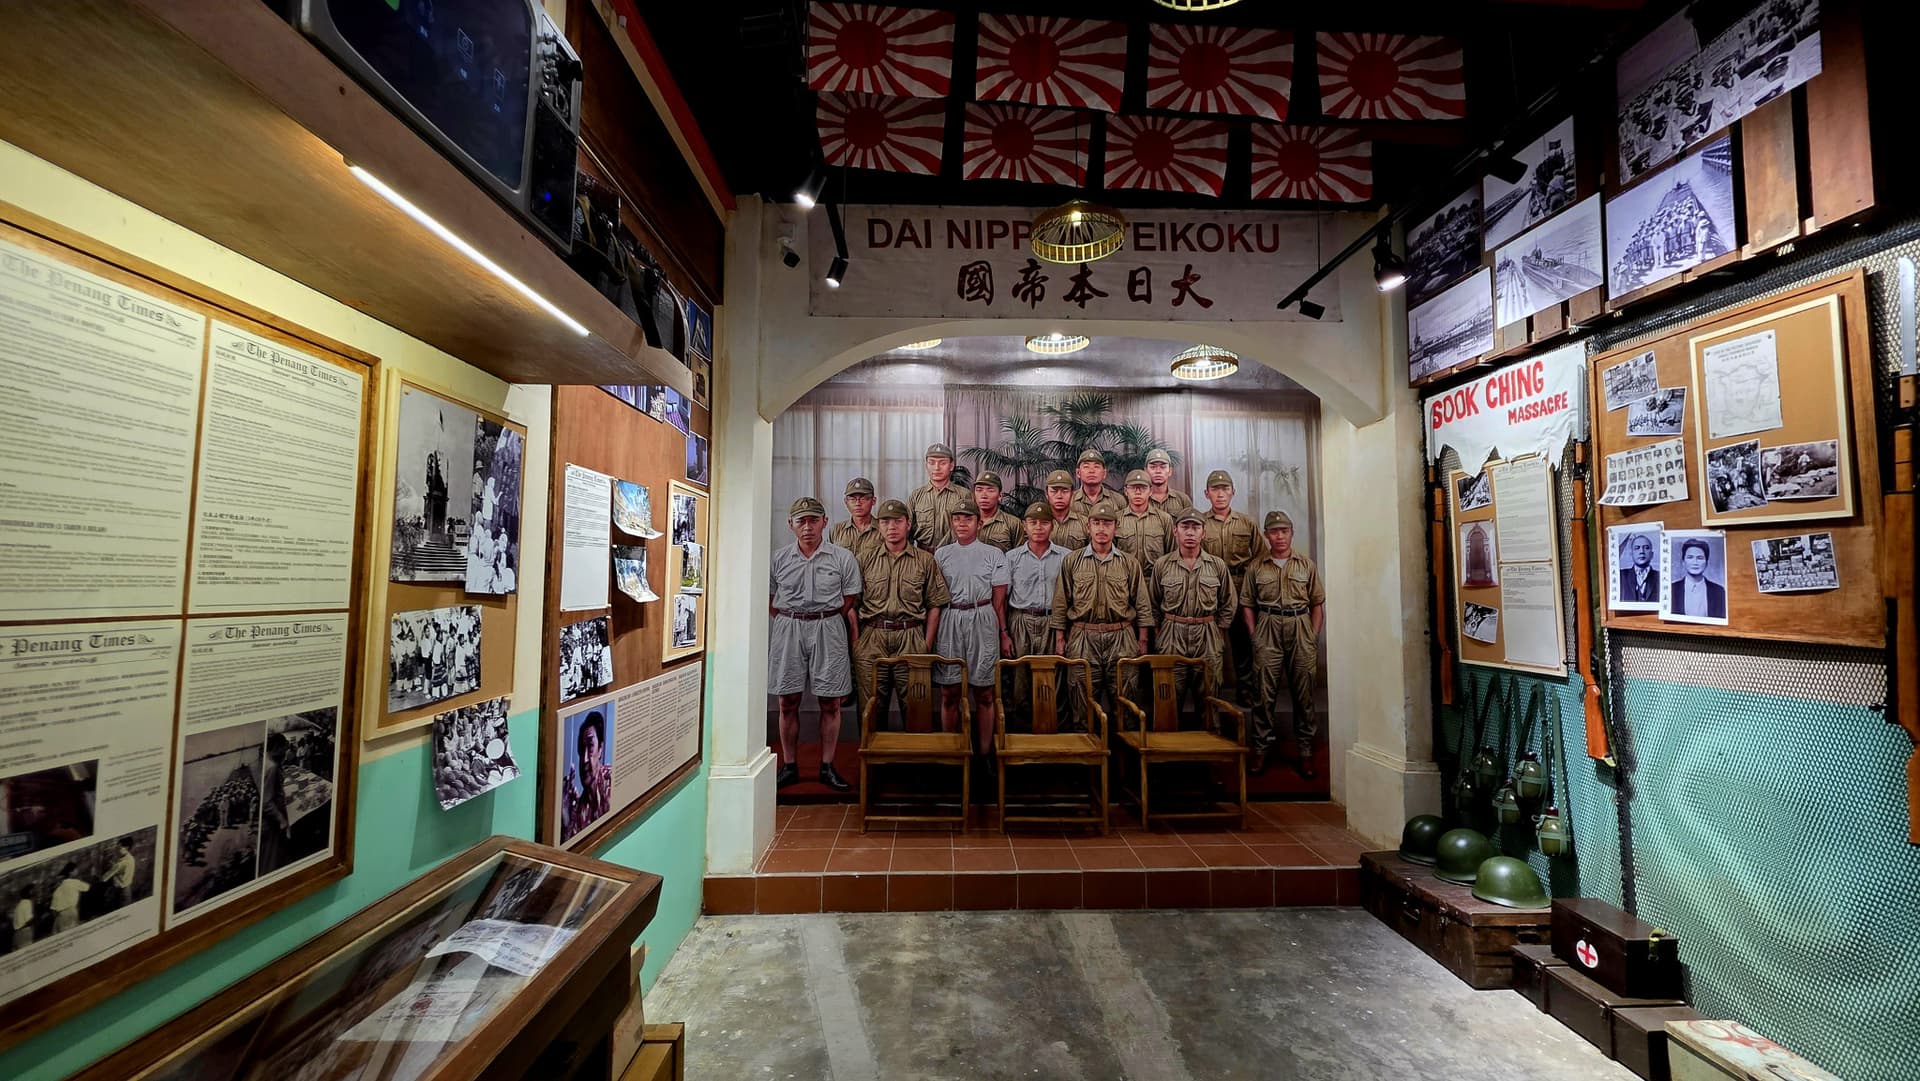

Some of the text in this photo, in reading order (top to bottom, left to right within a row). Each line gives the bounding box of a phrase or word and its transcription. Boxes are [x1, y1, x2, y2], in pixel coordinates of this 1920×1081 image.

[867, 218, 932, 249] DAI
[1126, 222, 1280, 253] EIKOKU
[46, 268, 113, 307] Penang
[117, 294, 164, 322] Times
[246, 342, 267, 360] The
[269, 350, 308, 375] Penang
[310, 365, 338, 384] Times
[1431, 360, 1544, 430] SOOK CHING
[1508, 391, 1568, 426] MASSACRE
[11, 637, 83, 656] Penang
[89, 634, 136, 649] Times
[224, 623, 322, 639] The Penang Times
